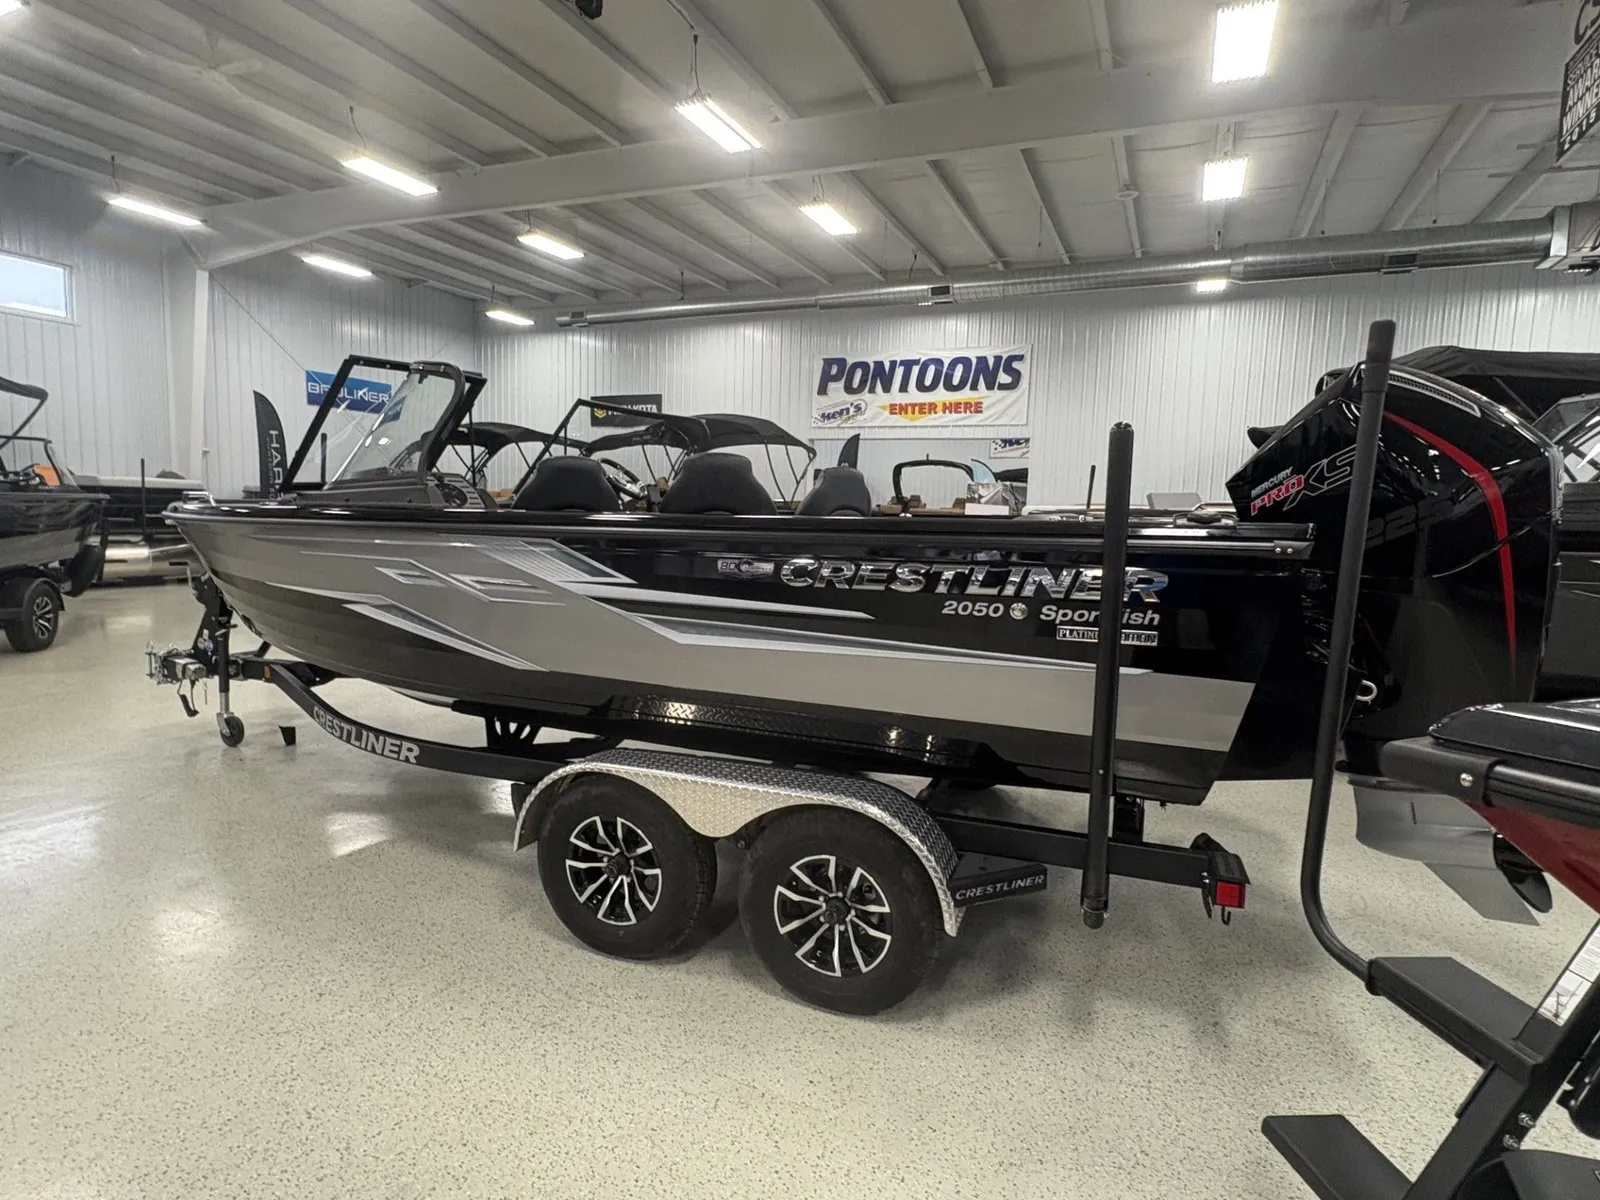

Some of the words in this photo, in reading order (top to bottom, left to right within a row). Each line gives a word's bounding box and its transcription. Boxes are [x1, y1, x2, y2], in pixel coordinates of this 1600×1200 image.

[1566, 57, 1600, 113] AWAR
[1563, 79, 1600, 136] WINNE
[1563, 107, 1597, 150] 2015
[817, 354, 1025, 396] PONTOONS
[888, 402, 938, 416] ENTER
[942, 401, 984, 414] HERE
[1250, 474, 1305, 517] PRO
[1251, 466, 1293, 499] MERCURY
[780, 558, 1169, 603] CRESTLINER
[941, 600, 1004, 618] 2050
[1039, 604, 1161, 626] Sporish
[1058, 628, 1099, 641] PLATIN
[313, 705, 420, 764] CRESTLINER
[955, 874, 1045, 900] CRESTLINER
